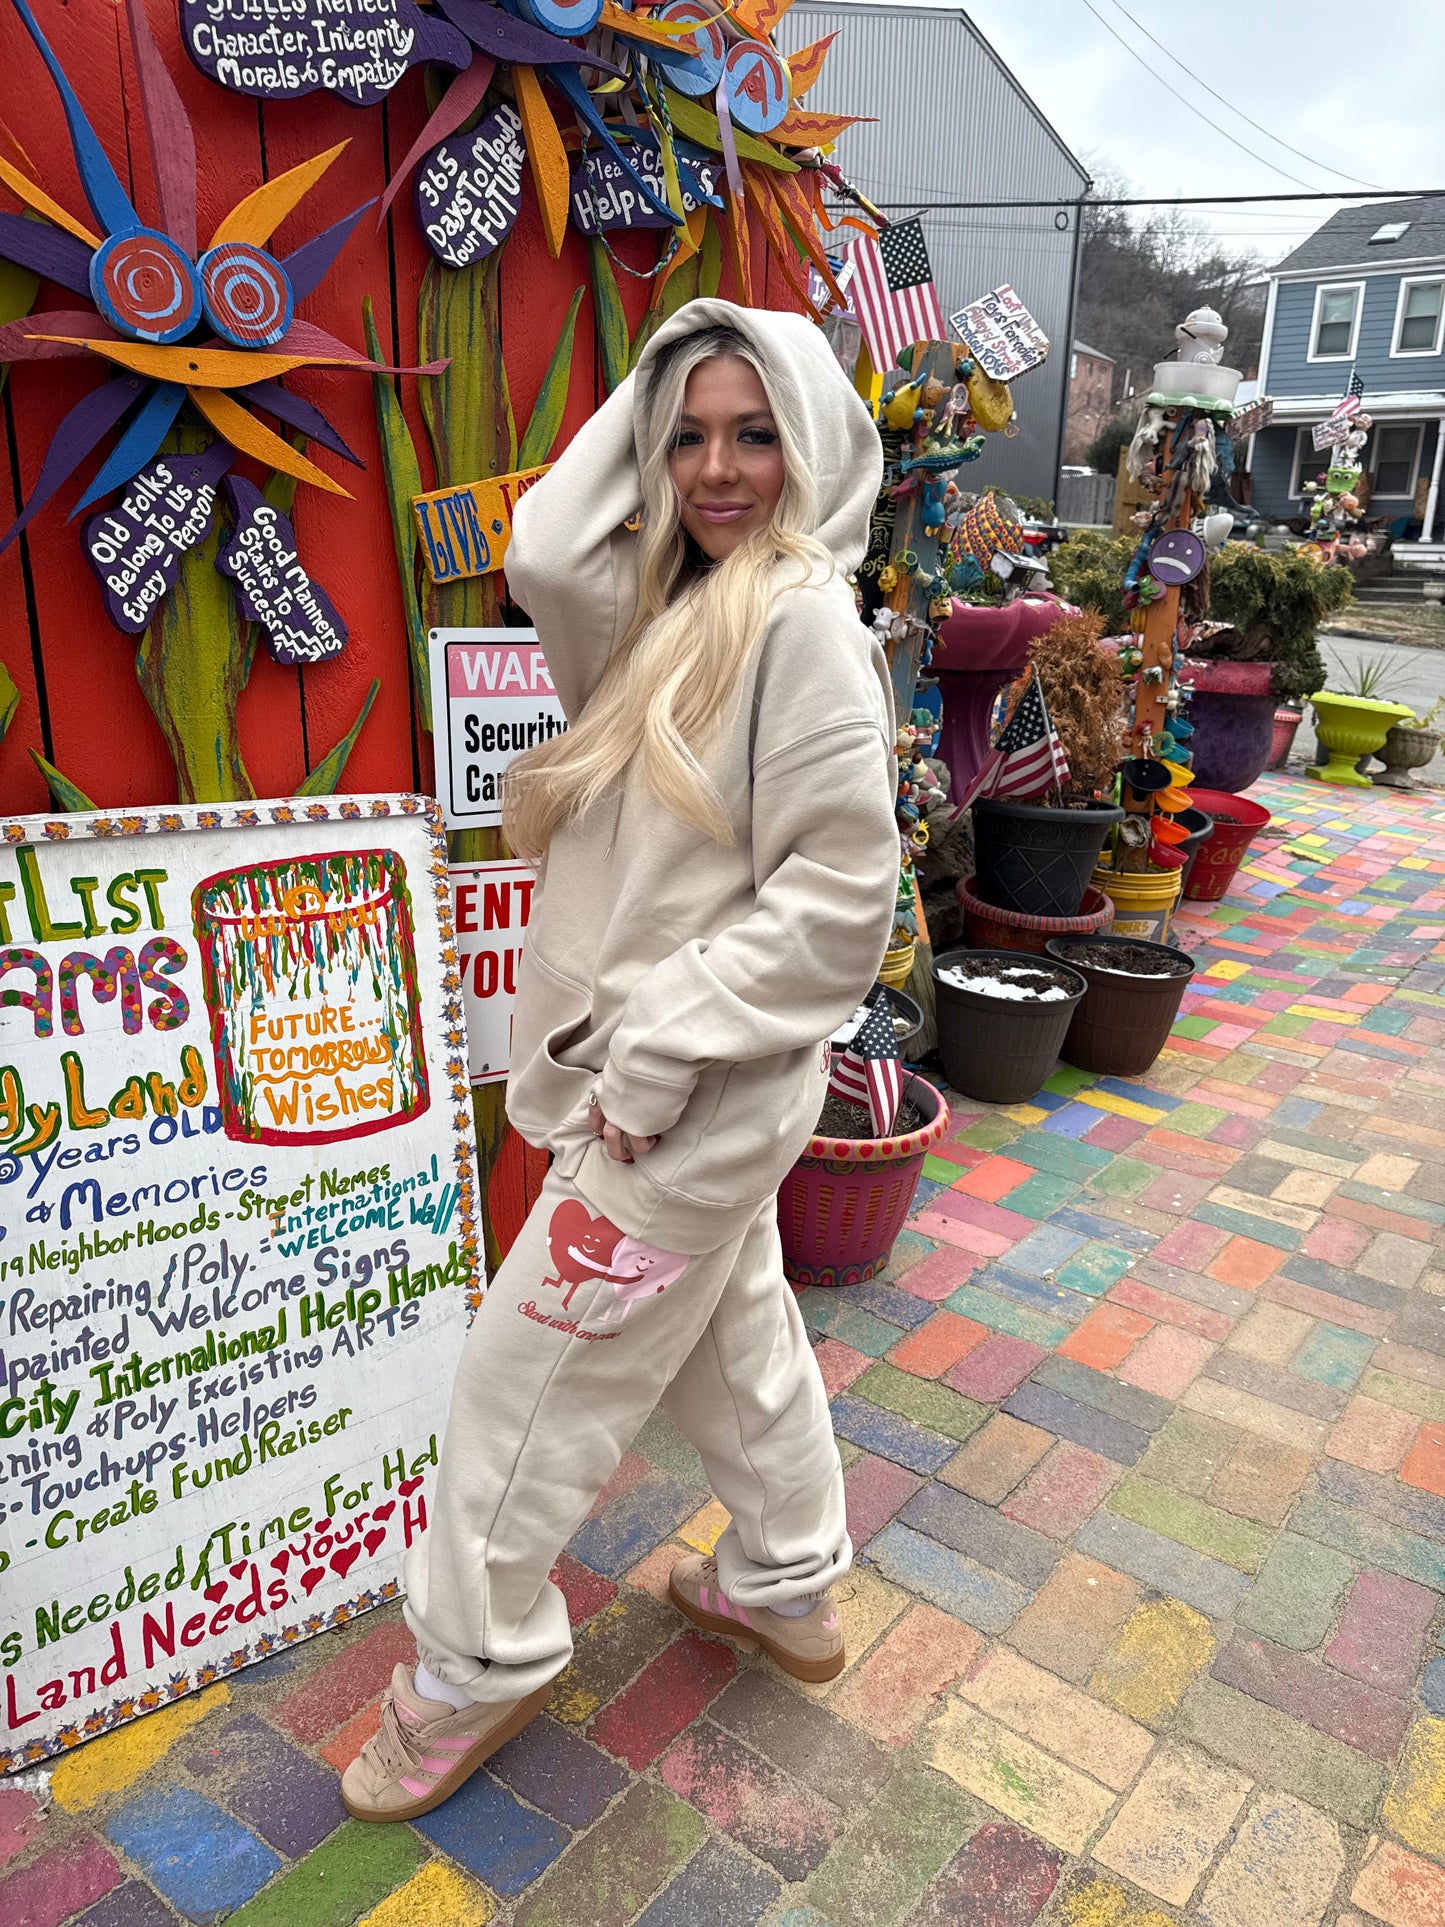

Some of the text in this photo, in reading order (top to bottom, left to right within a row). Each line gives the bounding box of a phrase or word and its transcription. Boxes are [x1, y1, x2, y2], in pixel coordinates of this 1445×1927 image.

[193, 19, 415, 58] Character, Integrity
[216, 58, 300, 89] Morals
[321, 59, 409, 99] Empathy
[419, 147, 459, 207] 365
[443, 140, 526, 267] Your FUTURE
[586, 157, 639, 181] Pleae
[574, 182, 635, 230] Help
[953, 312, 985, 355] Broken
[981, 291, 1008, 324] Toys
[997, 286, 1024, 314] Lost
[965, 305, 994, 340] Alleys
[992, 340, 1020, 374] Streets
[91, 464, 173, 563] Old Folks
[107, 484, 193, 597] Belong To Us
[416, 489, 490, 580] LIVE
[123, 569, 166, 624] Every
[168, 484, 216, 551] Person
[239, 527, 292, 615] Stairs To
[253, 507, 343, 652] Good Manners
[228, 550, 283, 632] Success
[460, 651, 555, 691] WAR
[16, 845, 169, 944] LIST
[60, 1045, 208, 1130] Land
[263, 1076, 395, 1125] Wishes
[149, 1106, 224, 1145] OLD
[60, 1165, 268, 1230] Memories
[320, 1163, 390, 1200] Names
[410, 1183, 460, 1236] Wall
[10, 1278, 151, 1336] Repairing
[269, 1153, 439, 1238] International
[148, 1274, 306, 1337] Welcome
[314, 1239, 410, 1289] Signs
[517, 1301, 552, 1324] Start
[548, 1319, 580, 1334] with
[0, 1378, 81, 1439] City
[300, 1286, 382, 1339] Help
[388, 1241, 474, 1306] Hands
[188, 1345, 323, 1410] Excisting
[333, 1300, 420, 1358] ARTS
[45, 1479, 158, 1549] Create
[35, 1545, 185, 1649] Needed
[211, 1506, 313, 1565] Time
[324, 1473, 373, 1517] For
[6, 1621, 128, 1729] Land
[143, 1563, 289, 1669] Needs
[288, 1512, 370, 1566] Your
